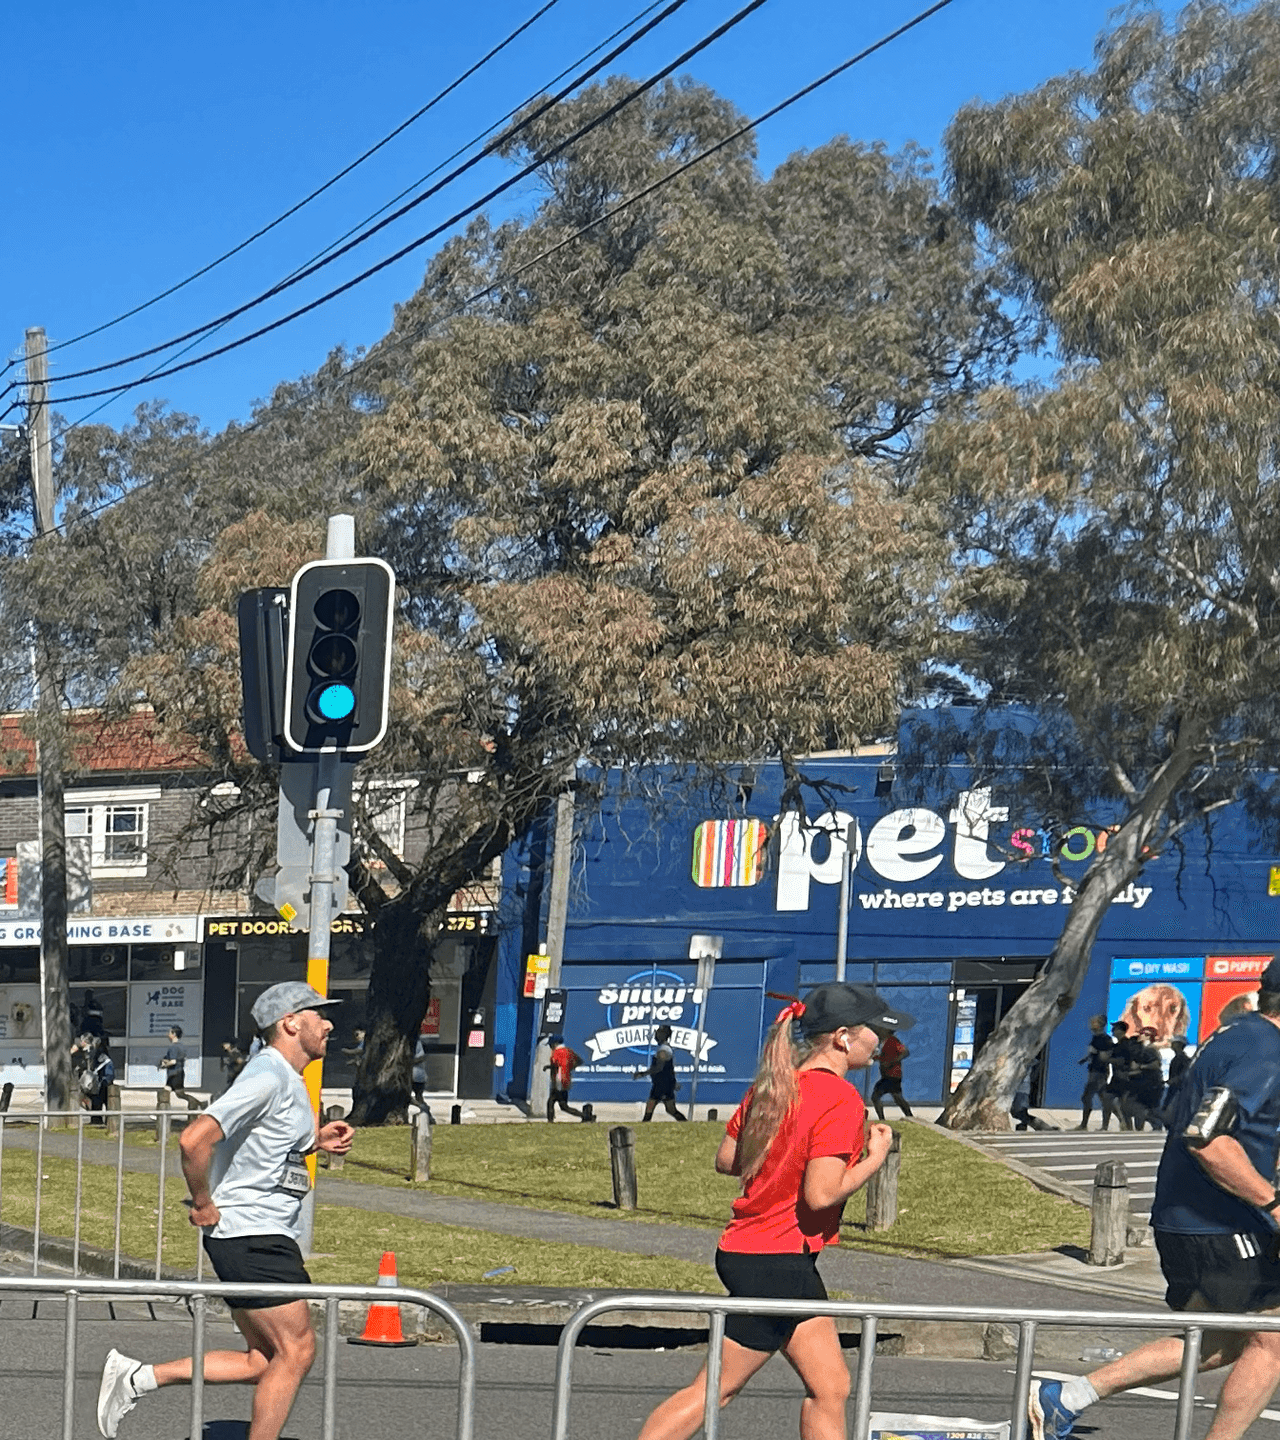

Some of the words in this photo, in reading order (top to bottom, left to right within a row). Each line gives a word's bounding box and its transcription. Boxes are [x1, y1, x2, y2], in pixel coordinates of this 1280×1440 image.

[859, 889, 944, 909] where
[947, 888, 1005, 911] pets
[1010, 888, 1058, 905] are
[1061, 882, 1153, 909] fily
[13, 926, 102, 940] GRMING
[108, 924, 152, 938] BASE
[208, 921, 239, 936] PET
[1162, 962, 1190, 974] WASH
[1229, 960, 1262, 973] PUPPY
[161, 986, 185, 995] DOG
[615, 1027, 692, 1047] GUAREE
